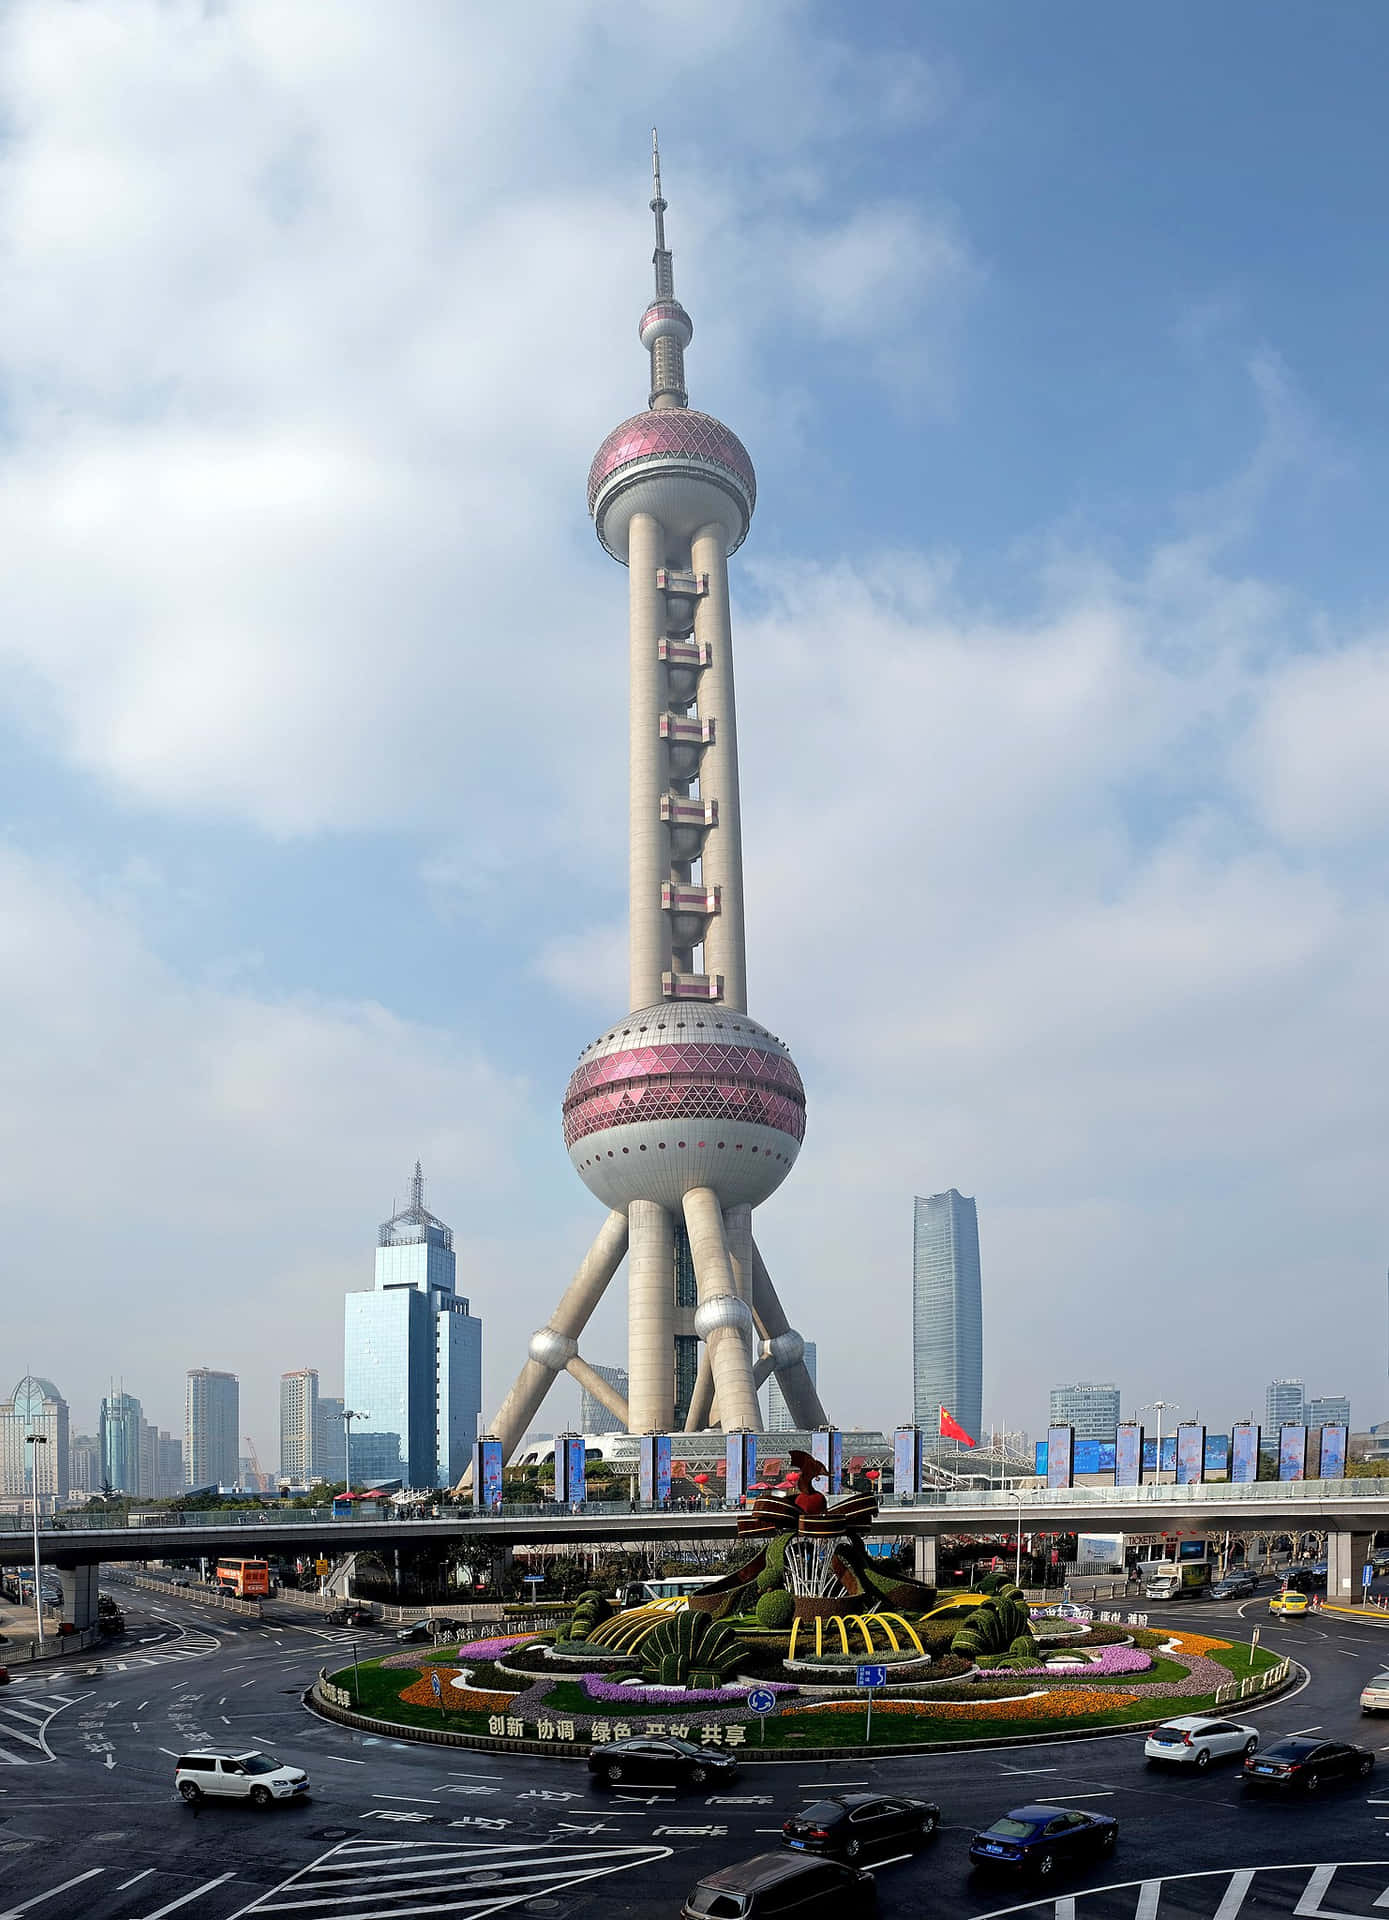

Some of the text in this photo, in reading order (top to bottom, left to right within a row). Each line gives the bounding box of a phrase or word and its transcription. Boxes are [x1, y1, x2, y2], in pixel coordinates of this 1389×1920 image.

[1128, 1535, 1157, 1545] TICKETS
[488, 1715, 524, 1737] 创新
[536, 1718, 575, 1741] 协调
[590, 1721, 632, 1743] 绿色
[701, 1724, 747, 1746] 共享
